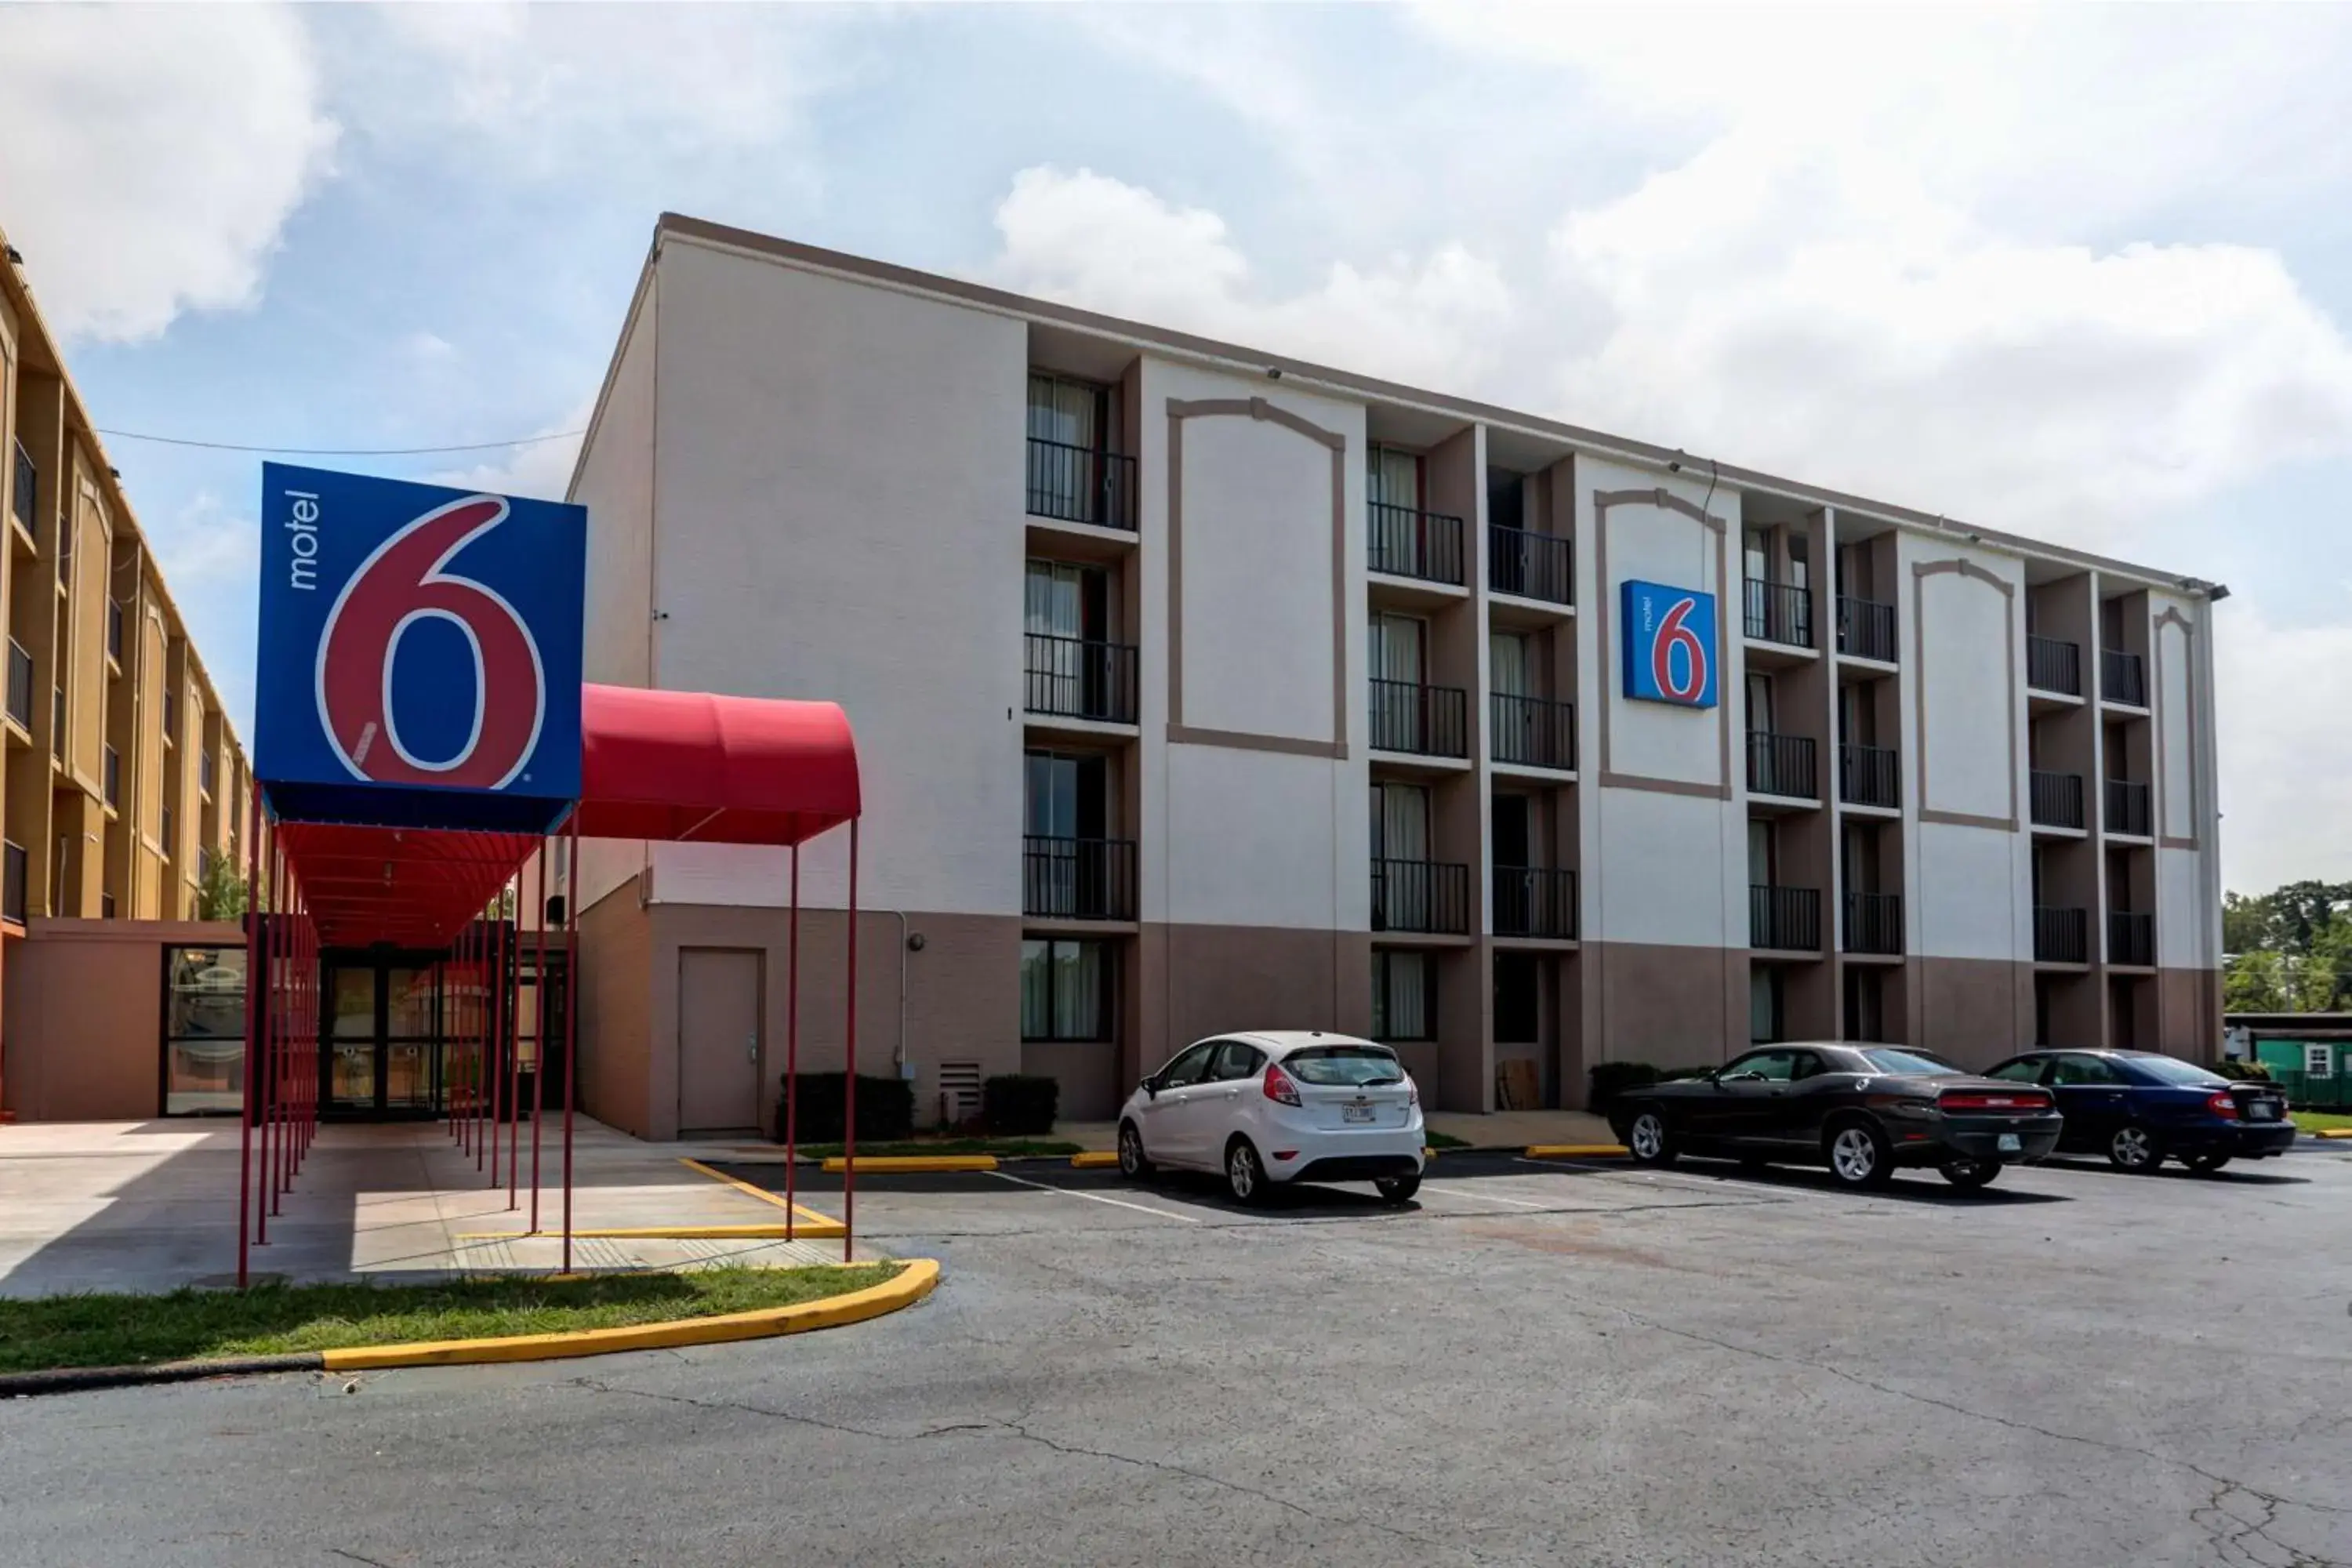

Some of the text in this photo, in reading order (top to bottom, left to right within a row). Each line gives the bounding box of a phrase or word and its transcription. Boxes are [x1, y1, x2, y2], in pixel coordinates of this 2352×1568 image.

[285, 489, 319, 590] motel
[315, 493, 546, 790] 6
[1652, 597, 1707, 702] 6
